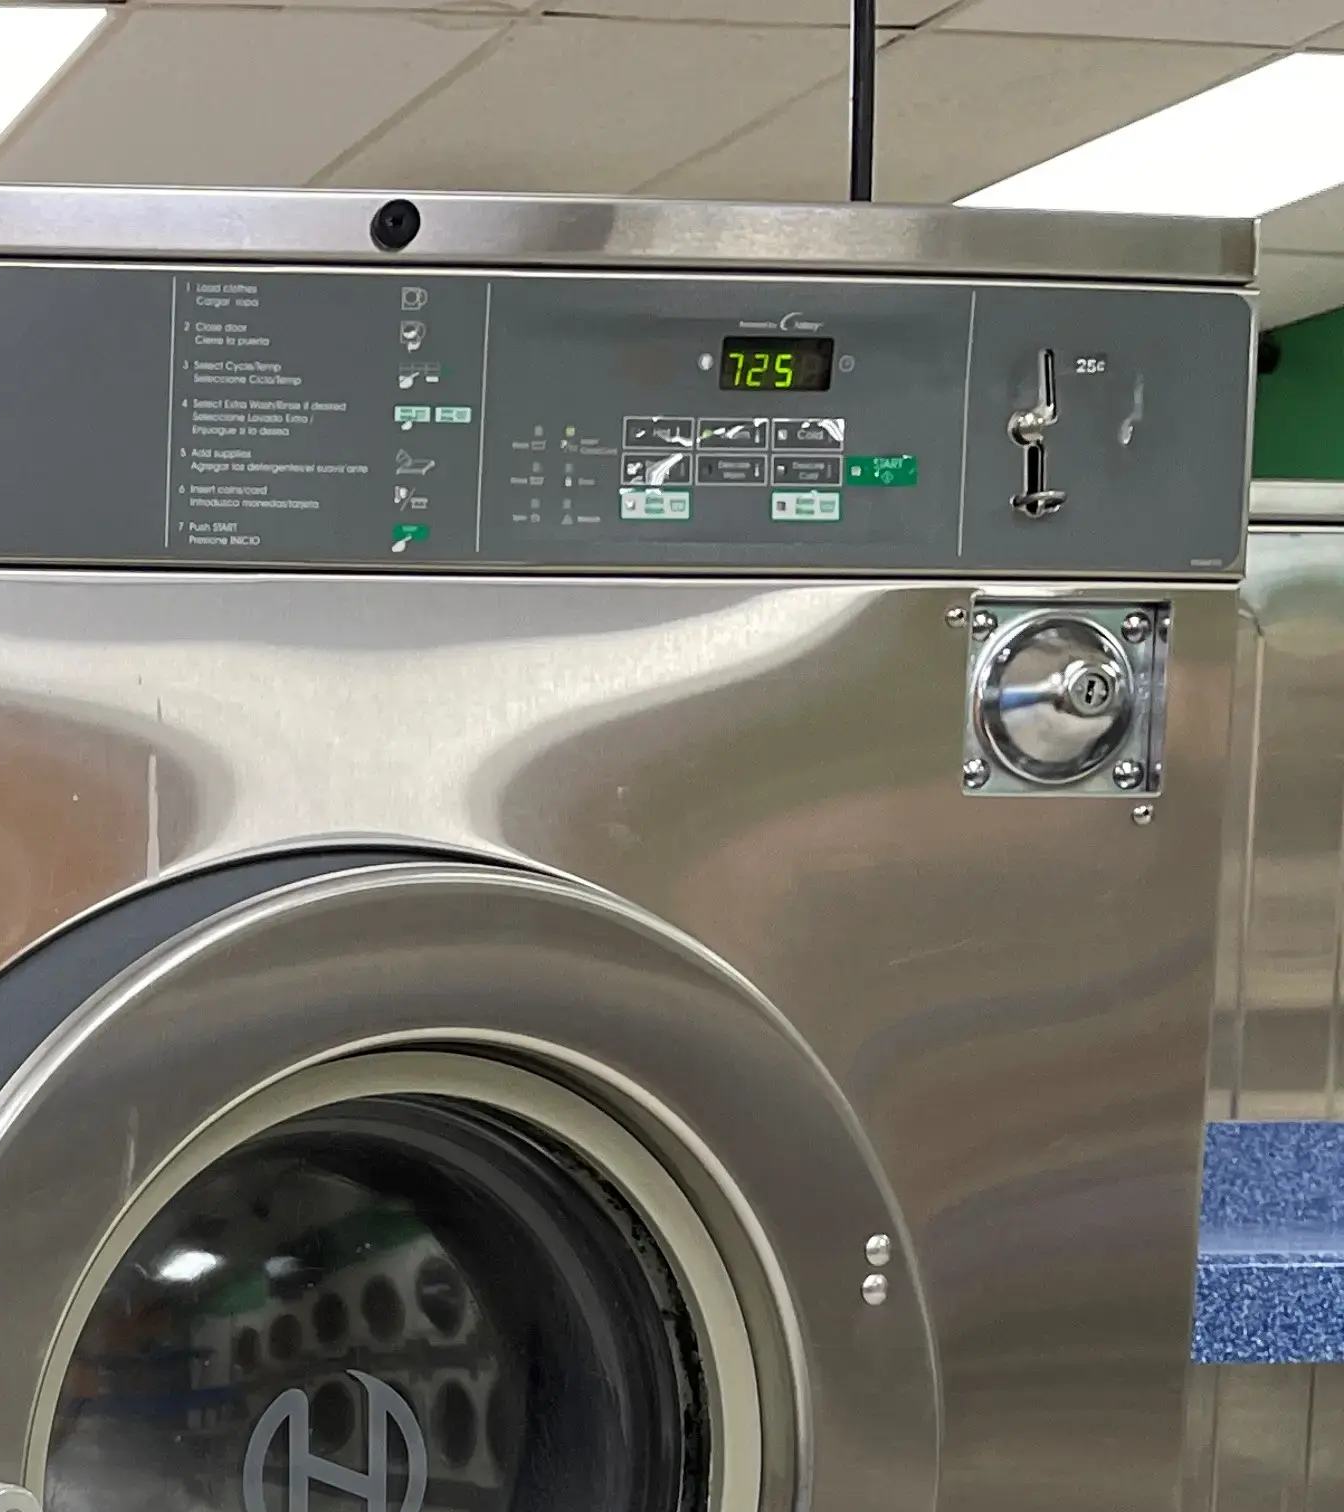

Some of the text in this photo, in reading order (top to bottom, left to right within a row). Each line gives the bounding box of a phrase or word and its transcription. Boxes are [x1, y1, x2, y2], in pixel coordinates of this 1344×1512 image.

[196, 283, 221, 293] Load
[195, 322, 223, 333] Close
[224, 322, 247, 333] door
[182, 361, 189, 371] 3
[194, 361, 223, 372] Select
[729, 353, 793, 387] 725
[181, 399, 188, 409] 4
[193, 399, 222, 410] Select
[223, 400, 247, 410] Extra
[191, 448, 211, 458] Add
[179, 485, 185, 495] 6
[190, 484, 215, 495] Insert
[178, 521, 237, 532] 7 Push START
